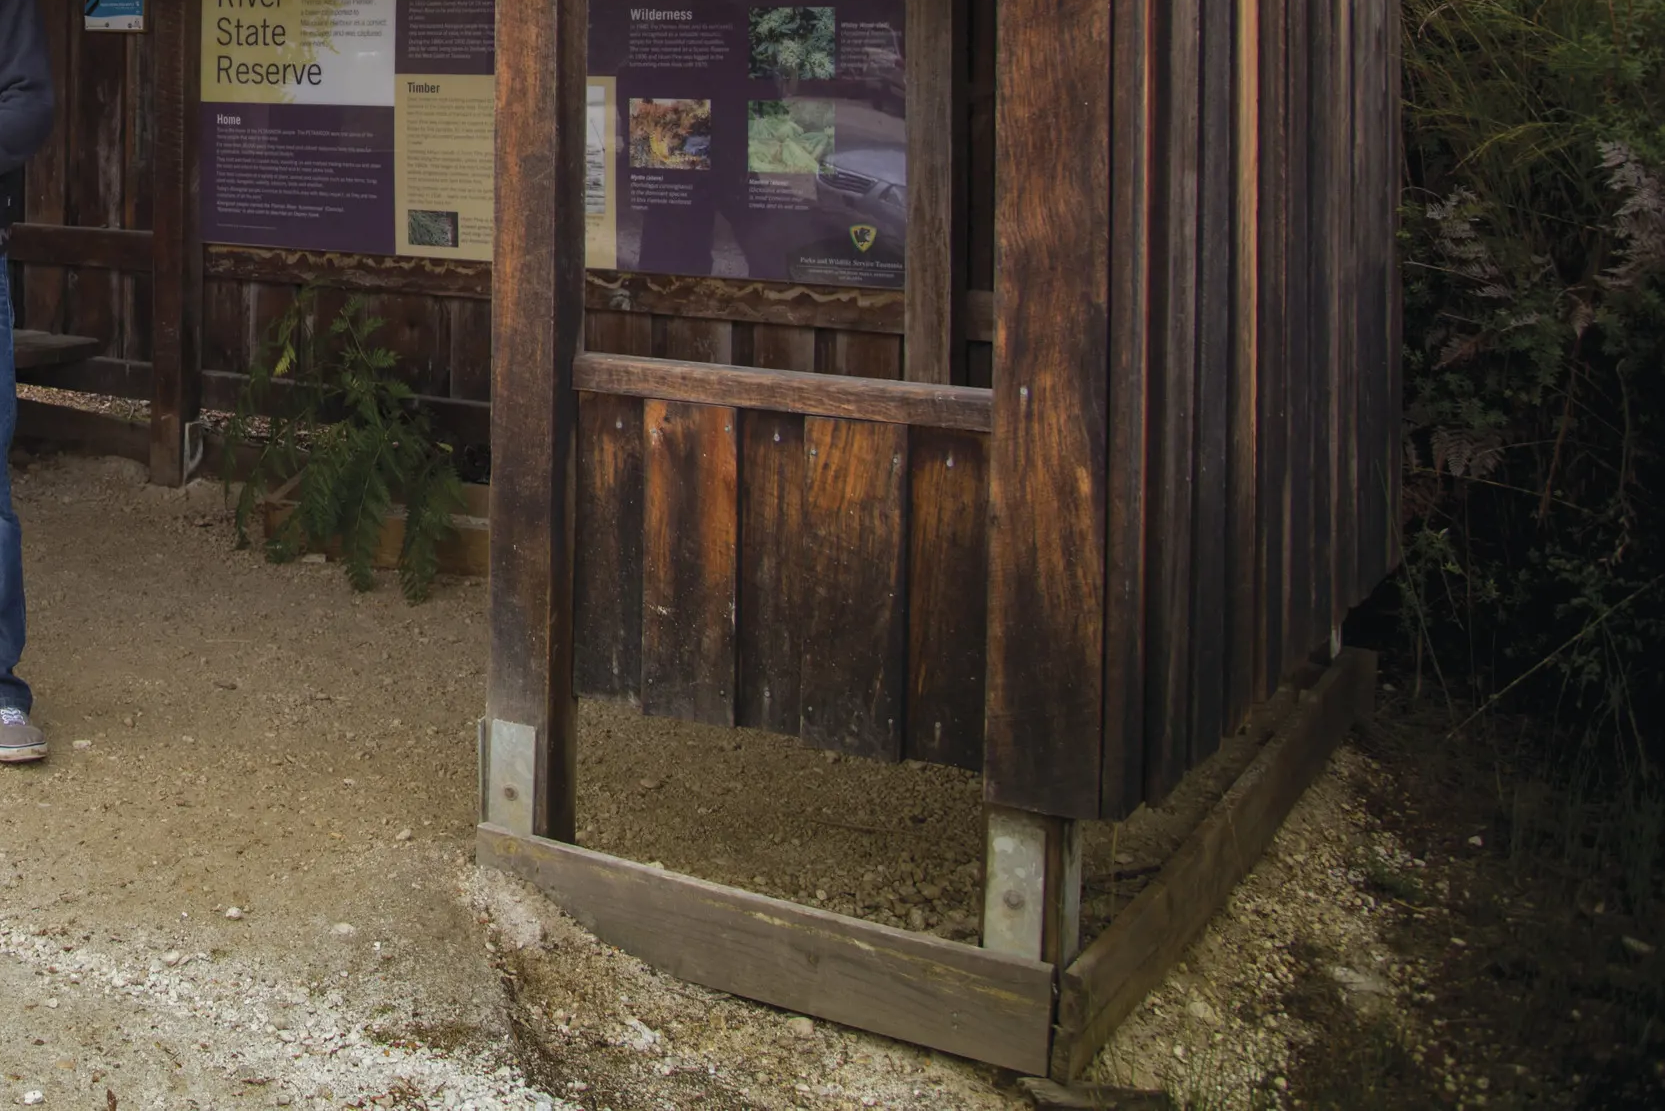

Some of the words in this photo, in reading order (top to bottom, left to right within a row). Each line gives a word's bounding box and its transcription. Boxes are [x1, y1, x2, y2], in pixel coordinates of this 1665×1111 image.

[630, 8, 692, 20] Wilderness
[216, 17, 286, 46] State
[216, 54, 323, 86] Reserve
[407, 82, 440, 94] Timber
[216, 114, 241, 125] Home
[828, 258, 851, 266] Wildlife
